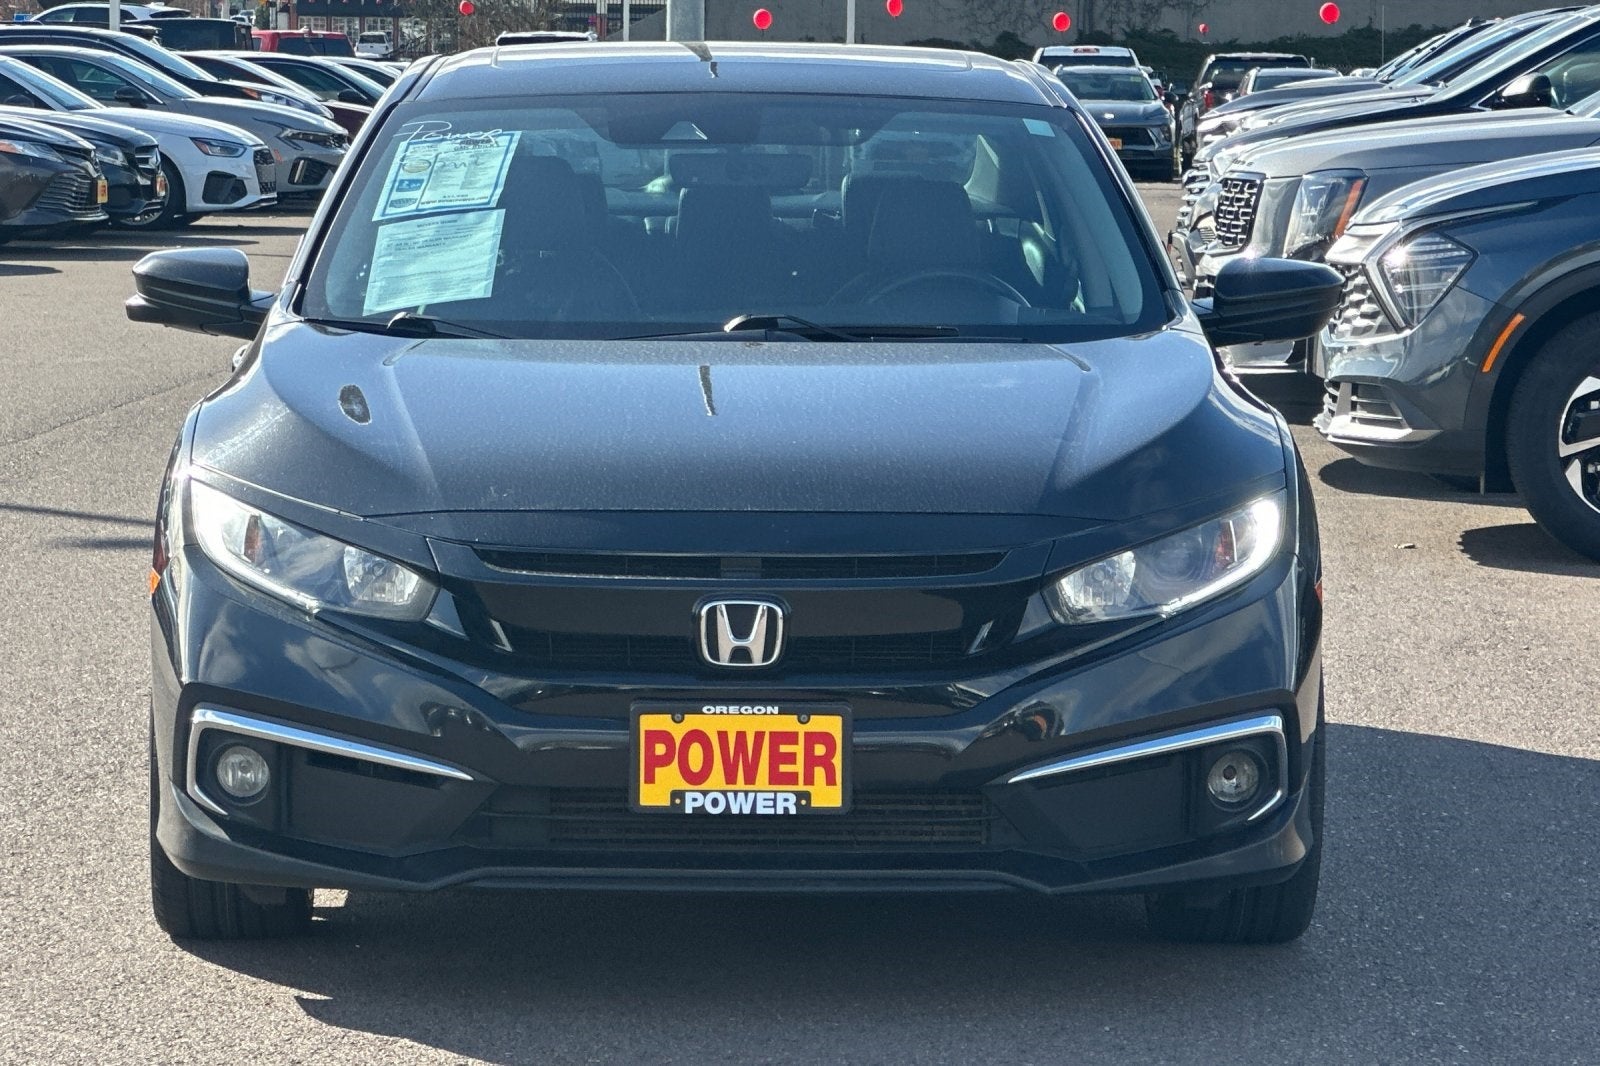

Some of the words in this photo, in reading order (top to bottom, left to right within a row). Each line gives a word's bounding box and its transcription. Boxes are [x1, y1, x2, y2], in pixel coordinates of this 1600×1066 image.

[702, 705, 779, 715] OREGON
[643, 729, 837, 787] POWER
[684, 791, 797, 815] POWER
